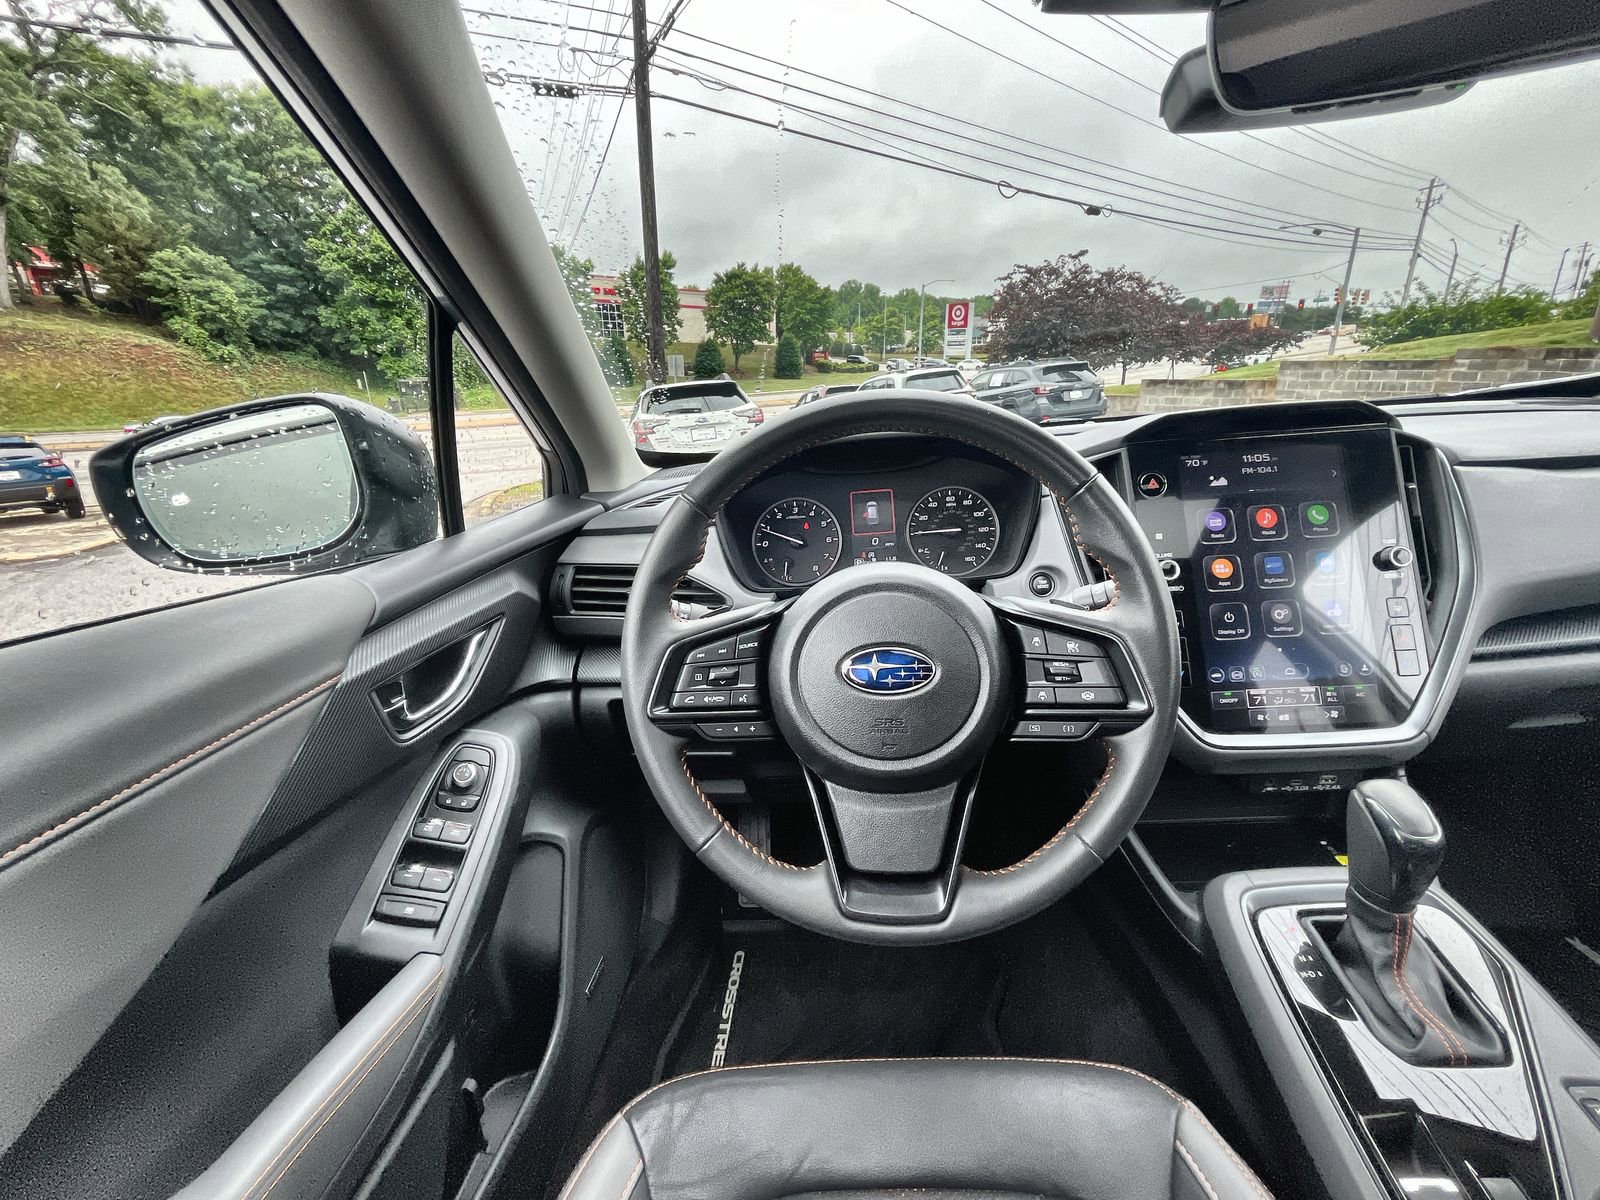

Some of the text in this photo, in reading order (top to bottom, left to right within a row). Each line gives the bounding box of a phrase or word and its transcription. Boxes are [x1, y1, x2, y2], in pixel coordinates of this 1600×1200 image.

[1242, 453, 1270, 463] 11:05
[1184, 459, 1200, 467] 70
[1241, 466, 1278, 475] FM-104.1
[871, 537, 879, 545] 0
[738, 641, 759, 650] SOURCE
[1253, 696, 1267, 705] 71
[1301, 694, 1315, 702] 71
[709, 950, 745, 1070] CROSSTRE
